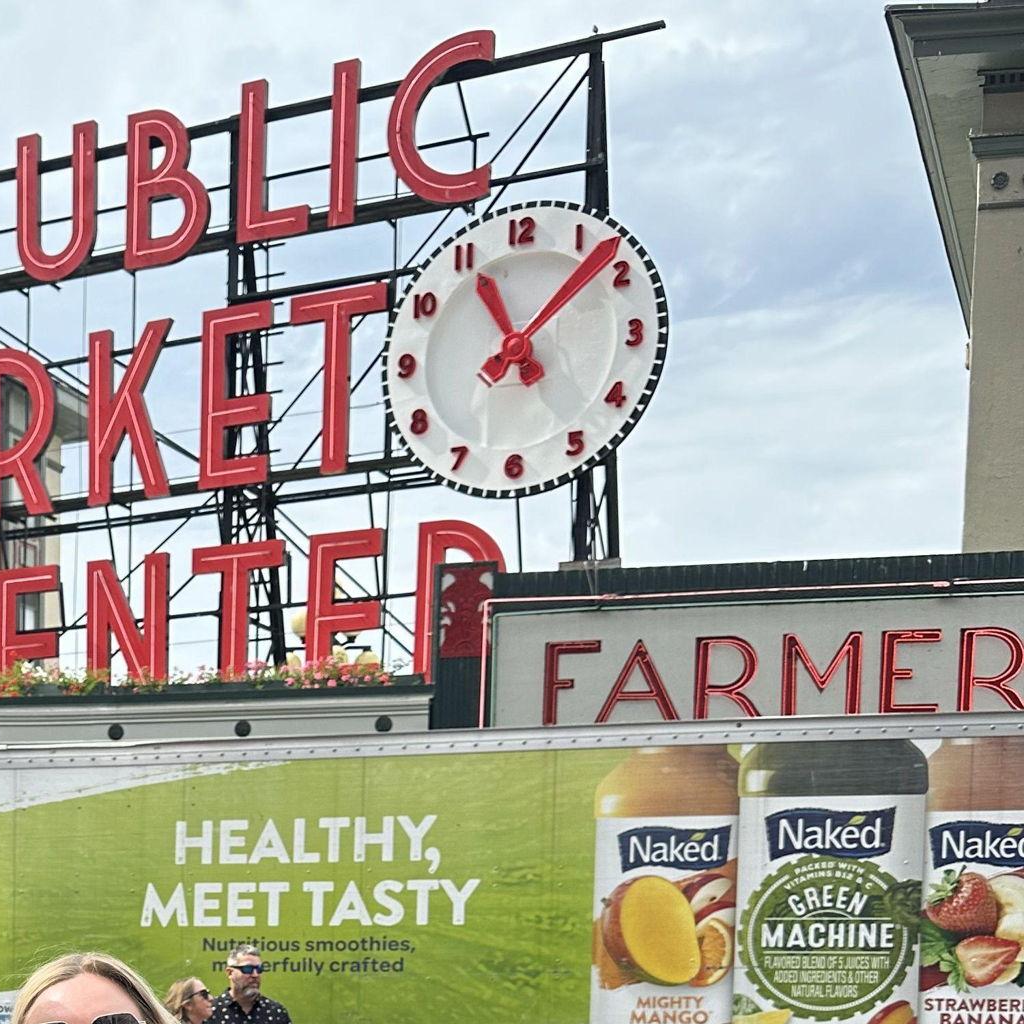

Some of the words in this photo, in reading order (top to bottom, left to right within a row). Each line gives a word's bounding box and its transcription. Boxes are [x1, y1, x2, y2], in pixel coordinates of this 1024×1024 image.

[508, 216, 535, 246] 12
[576, 223, 583, 251] 1
[455, 243, 473, 272] 11
[613, 261, 630, 288] 2
[413, 292, 436, 320] 10
[625, 318, 644, 347] 3
[398, 354, 416, 378] 9
[604, 381, 626, 408] 4
[410, 409, 429, 435] 8
[566, 430, 584, 456] 5
[451, 446, 470, 472] 7
[504, 454, 524, 480] 6
[543, 626, 1024, 726] FARMER
[174, 814, 441, 874] HEALTHY,
[784, 871, 832, 890] VITAMINS
[835, 871, 853, 880] B12
[794, 861, 836, 875] PACKED
[838, 862, 865, 874] WITH
[140, 881, 290, 928] MEET
[302, 878, 481, 926] TASTY
[788, 885, 868, 916] GREEN
[305, 936, 416, 954] smoothies,
[761, 923, 895, 948] MACHINE
[330, 957, 404, 972] crafted
[802, 956, 826, 969] BLEND
[827, 956, 837, 969] OF
[838, 956, 844, 969] 5
[844, 956, 869, 969] JUICES
[870, 956, 890, 969] WITH
[773, 971, 798, 984] ADDED
[800, 971, 846, 984] INGREDIENTS
[855, 971, 879, 984] OTHER
[637, 996, 704, 1008] MIGHTY
[791, 985, 824, 998] NATURAL
[825, 985, 858, 998] FLAVORS
[629, 1010, 709, 1024] MANGO
[924, 998, 1024, 1012] STRAWBER
